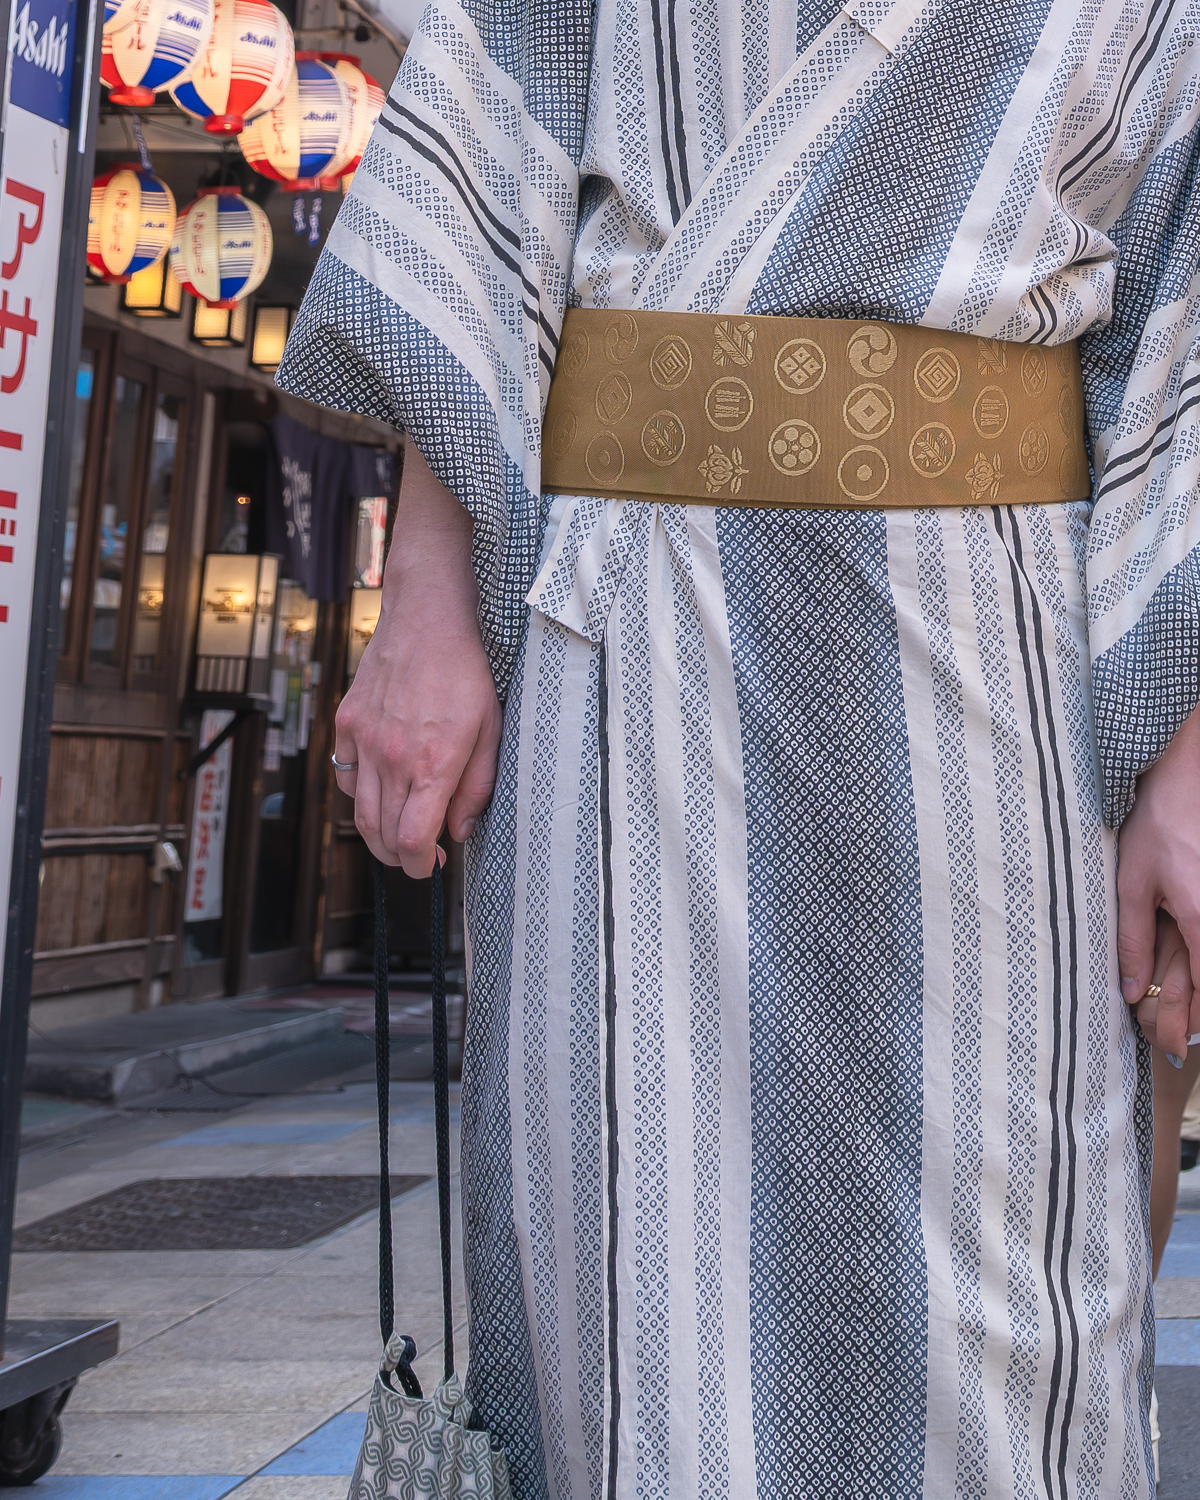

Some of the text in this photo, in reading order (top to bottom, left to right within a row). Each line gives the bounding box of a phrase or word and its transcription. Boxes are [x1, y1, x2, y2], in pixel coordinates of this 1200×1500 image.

[167, 10, 203, 32] Asahi
[13, 0, 70, 78] Asahi
[239, 31, 277, 49] Asahi
[303, 110, 338, 122] Asahi
